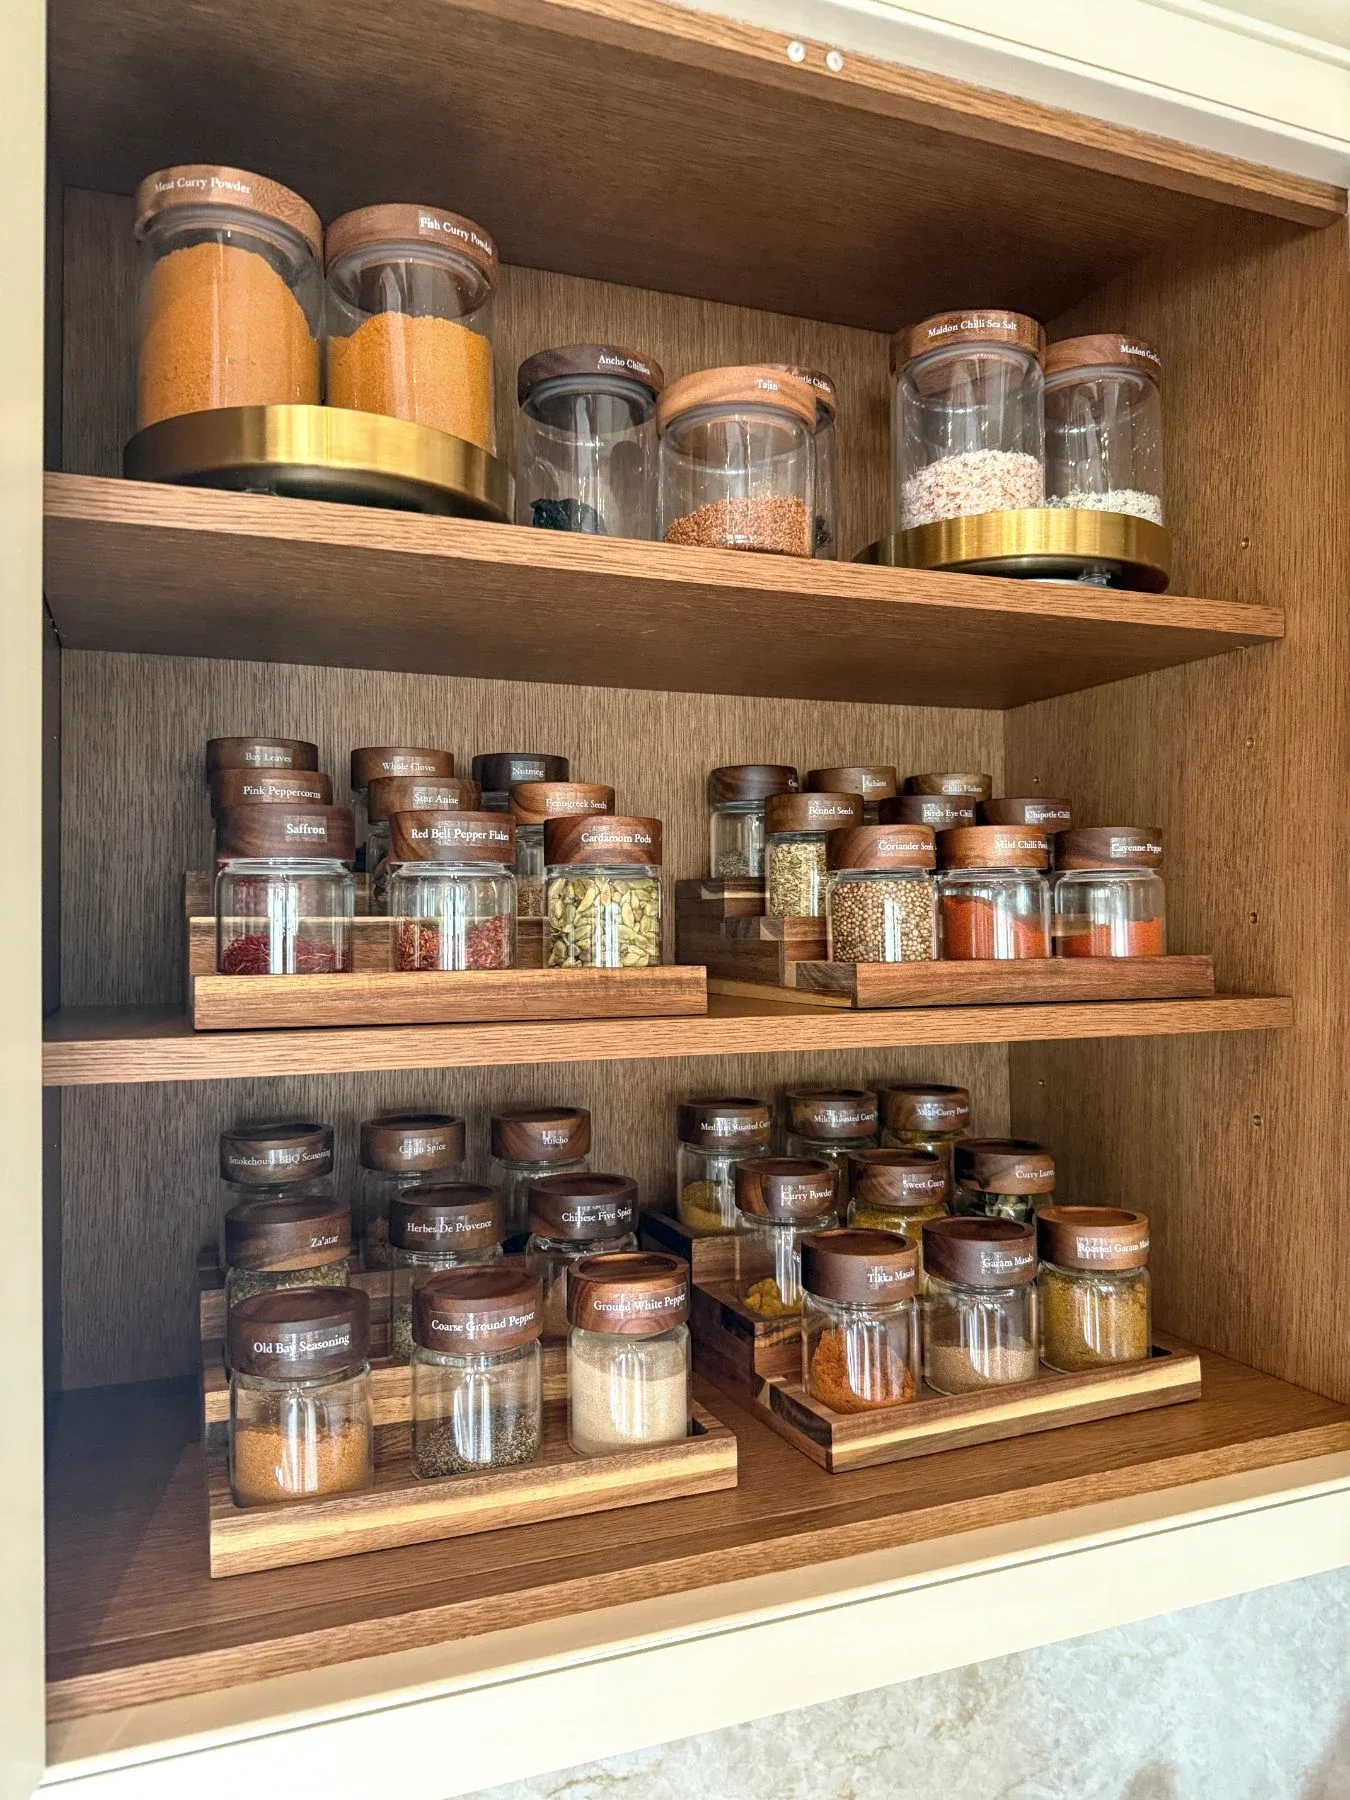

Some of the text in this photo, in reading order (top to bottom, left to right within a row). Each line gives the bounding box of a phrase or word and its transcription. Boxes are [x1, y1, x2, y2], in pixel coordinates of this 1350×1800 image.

[155, 177, 251, 193] Meat Curry Powder
[420, 216, 441, 230] Fish
[443, 222, 470, 241] Curry
[928, 319, 1018, 338] Maldon Chilli Sea Salt
[1120, 343, 1146, 357] Maldon
[598, 355, 626, 367] Ancho
[245, 751, 291, 763] Bay Leaves
[382, 761, 436, 772] Whole Cloves
[512, 767, 544, 778] Nutmeg
[243, 785, 321, 799] Pink Peppercorns
[414, 793, 459, 805] Star Anise
[836, 806, 855, 815] Seeds
[923, 808, 944, 818] Birds
[945, 808, 959, 819] Eye
[1026, 809, 1058, 821] Chipotle
[286, 822, 326, 835] Saffron
[411, 828, 509, 844] Red Bell Pepper Flakes
[581, 832, 652, 845] Cardamom Pods
[879, 840, 920, 850] Coriander
[995, 839, 1016, 849] Mild
[1018, 840, 1037, 849] Chilli
[1112, 843, 1146, 853] Cayenne
[936, 1108, 955, 1118] Curry
[426, 1142, 446, 1154] Spice
[280, 1153, 301, 1165] BBQ
[1015, 1170, 1038, 1181] Curry
[903, 1180, 926, 1189] Sweet
[783, 1190, 808, 1202] Curry
[561, 1212, 597, 1222] Chinese
[598, 1210, 616, 1221] Five
[407, 1220, 493, 1233] Herbes De Provence
[310, 1235, 339, 1248] Za'atar
[1079, 1242, 1112, 1253] Roasted
[1113, 1243, 1139, 1253] Garam
[982, 1258, 1013, 1269] Garam
[867, 1271, 893, 1283] Tikka
[593, 1294, 686, 1311] Ground White Pepper
[431, 1312, 535, 1332] Coarse Ground Pepper
[253, 1334, 350, 1355] Old Bay Seasoning
